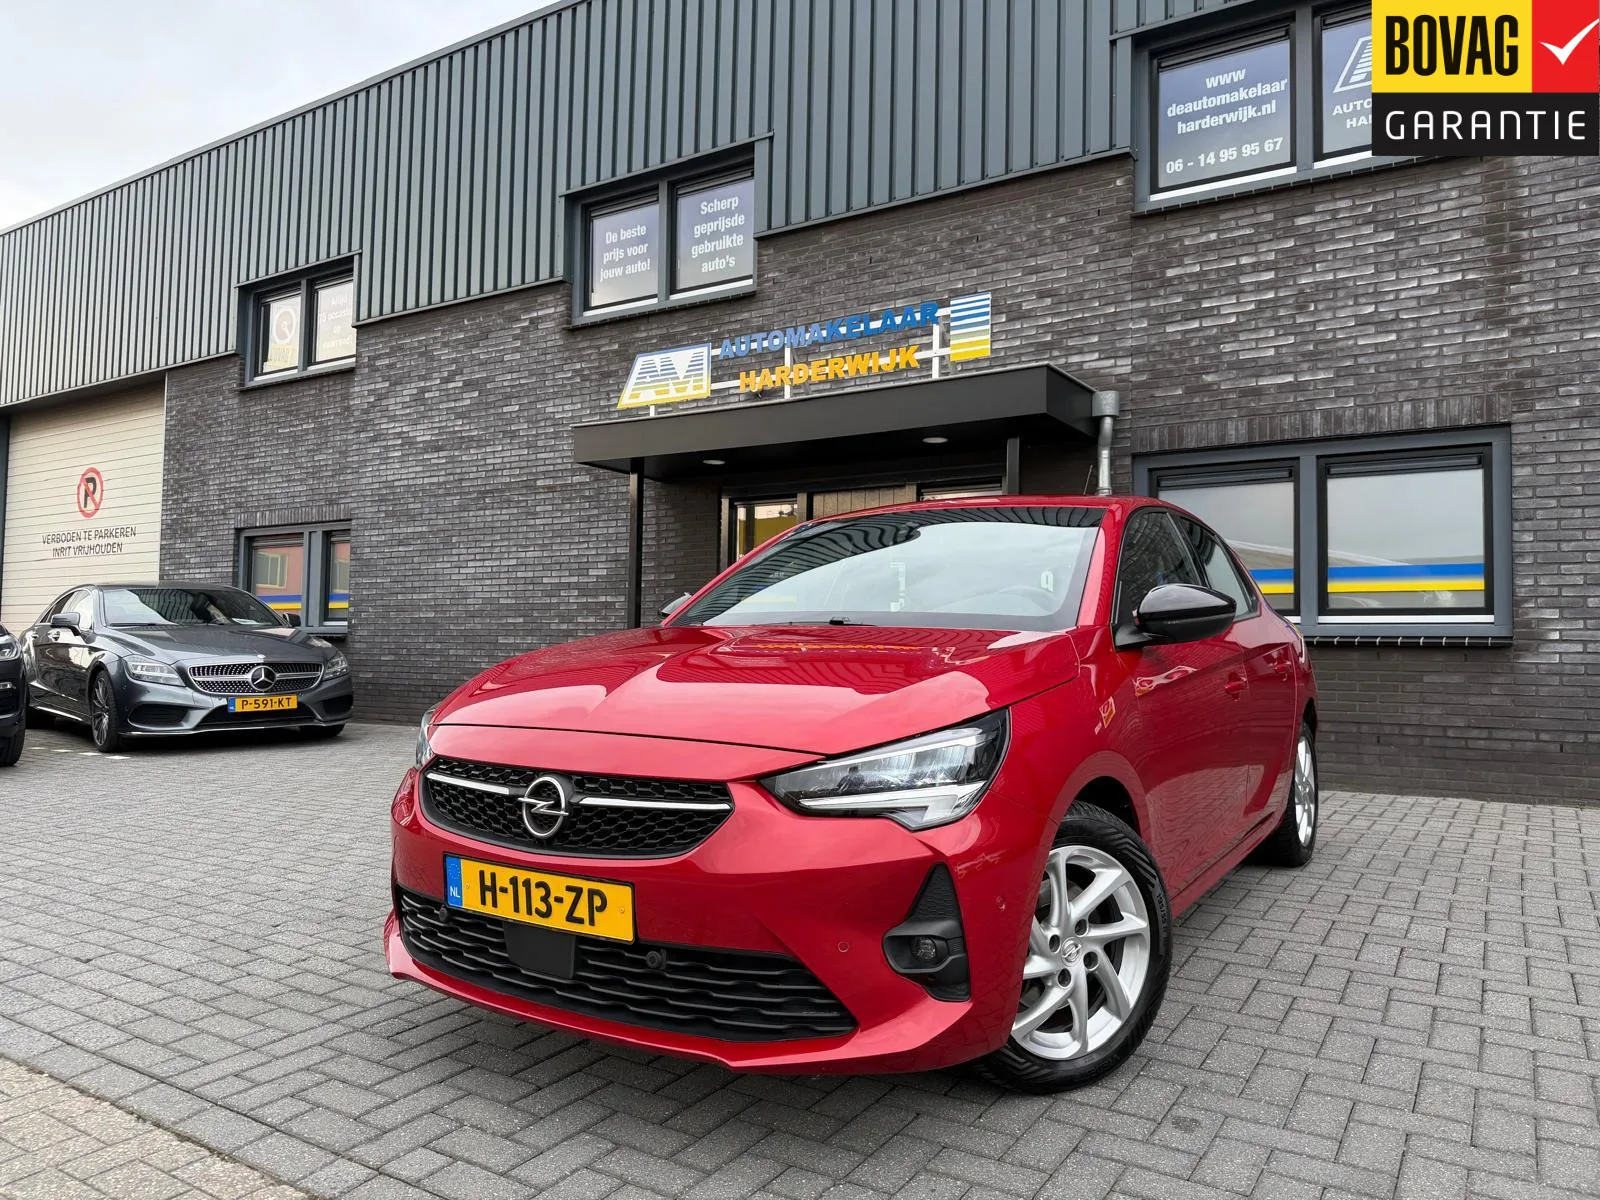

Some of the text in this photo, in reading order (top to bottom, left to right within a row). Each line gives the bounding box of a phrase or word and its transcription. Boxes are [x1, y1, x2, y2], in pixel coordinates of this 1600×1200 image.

[1205, 66, 1246, 89] www
[1167, 77, 1288, 118] deautomakelaar
[1177, 99, 1277, 135] harderwijk.nl
[1165, 159, 1184, 174] 06
[1198, 152, 1216, 168] 14
[1219, 147, 1238, 163] 95
[1241, 142, 1261, 158] 95
[1264, 137, 1284, 153] 67
[700, 196, 739, 215] Scherp
[605, 224, 647, 245] De beste
[693, 214, 745, 238] geprijsde
[603, 243, 649, 264] prijs voor
[691, 233, 744, 258] gebruikte
[600, 258, 651, 282] jouw auto!
[701, 255, 736, 273] auto's
[718, 301, 939, 360] AUTOMAKELAAR
[739, 345, 920, 393] HARDERWIJK
[42, 526, 137, 545] VERBODEN TE PARKEREN
[52, 542, 123, 558] INRIT VRIJHOUDEN
[241, 697, 292, 710] P-591-KT
[450, 869, 608, 927] NL H-113-ZP
